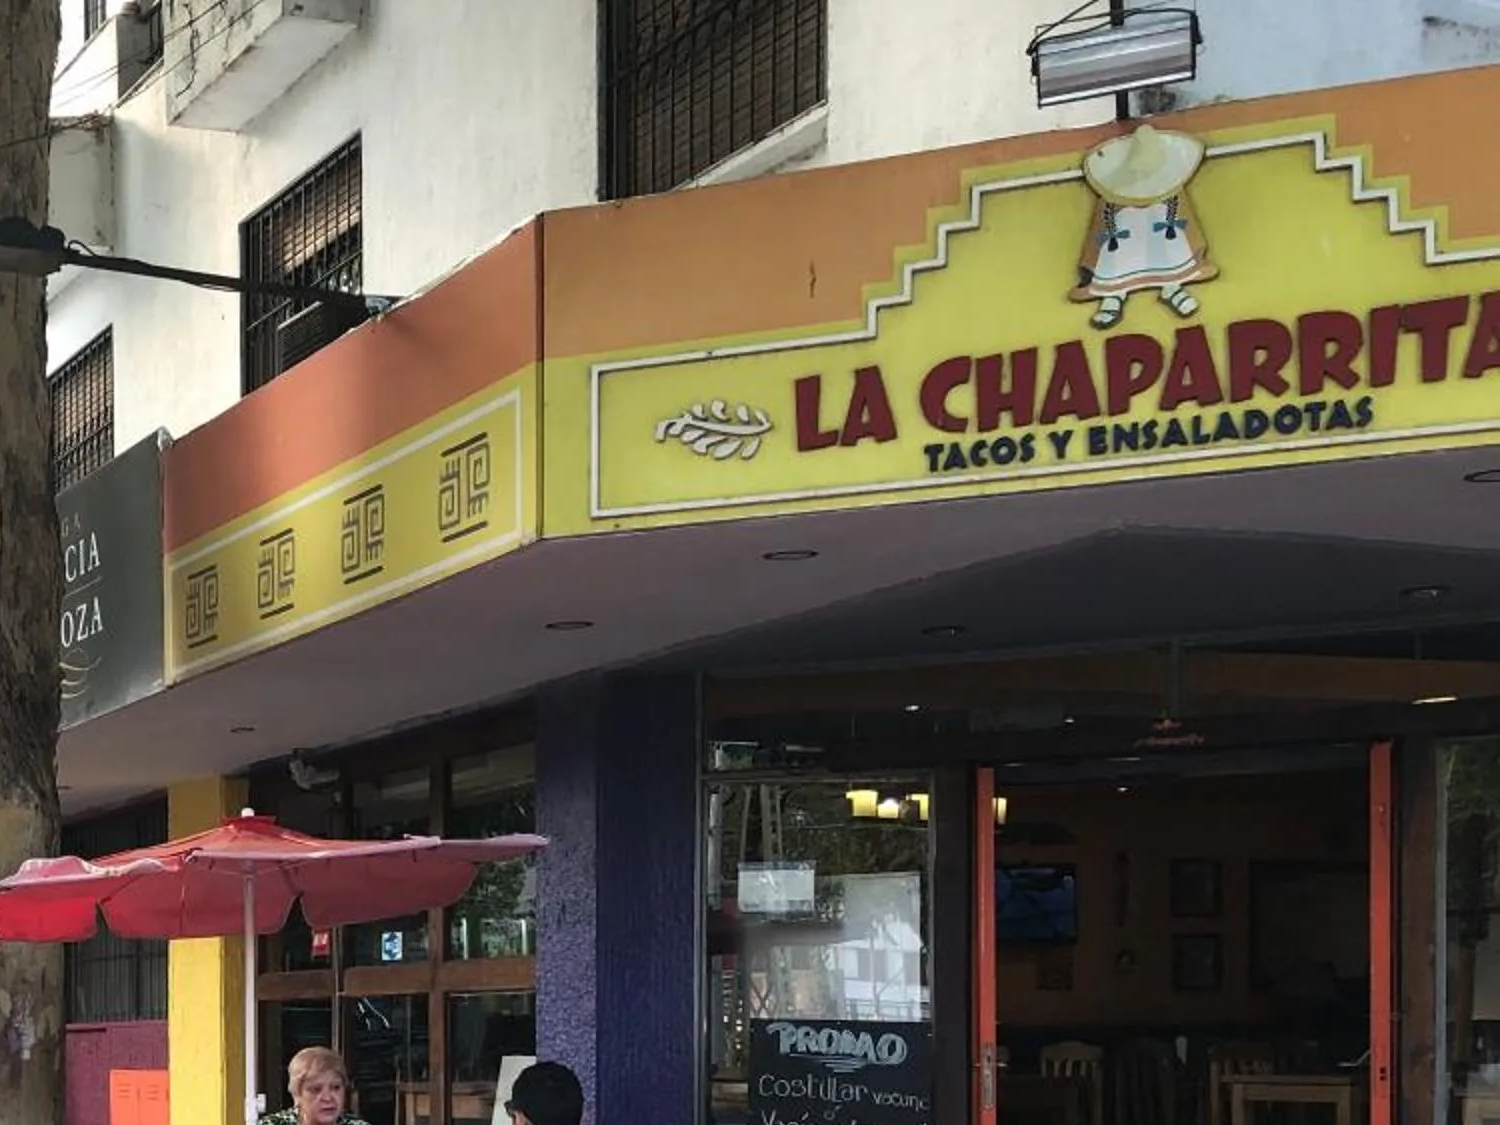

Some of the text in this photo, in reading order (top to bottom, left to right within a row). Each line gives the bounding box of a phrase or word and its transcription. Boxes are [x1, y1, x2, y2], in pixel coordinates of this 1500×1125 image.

[795, 365, 898, 453] LA
[924, 396, 1374, 472] TACOS Y ENSALADOTAS
[766, 1022, 908, 1065] PROMO
